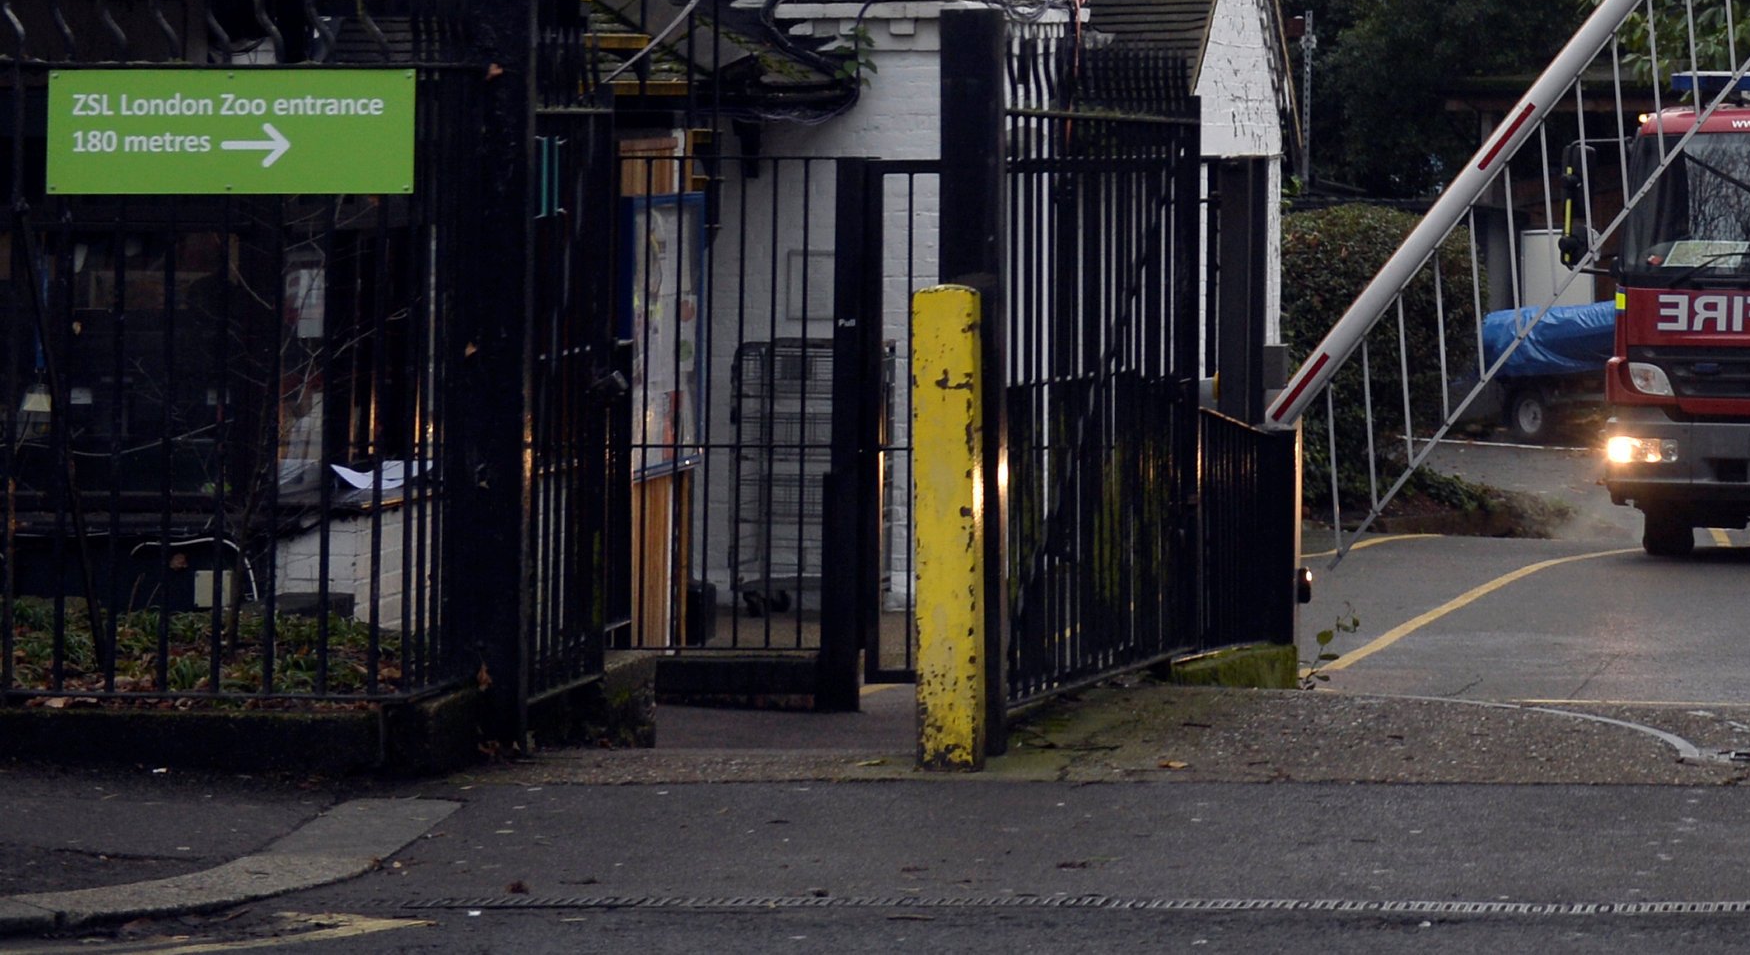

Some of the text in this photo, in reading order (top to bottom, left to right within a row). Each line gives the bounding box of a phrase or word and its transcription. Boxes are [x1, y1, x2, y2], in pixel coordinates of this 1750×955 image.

[72, 93, 385, 115] ZSL London Zoo entrance
[72, 131, 212, 152] 180 metres
